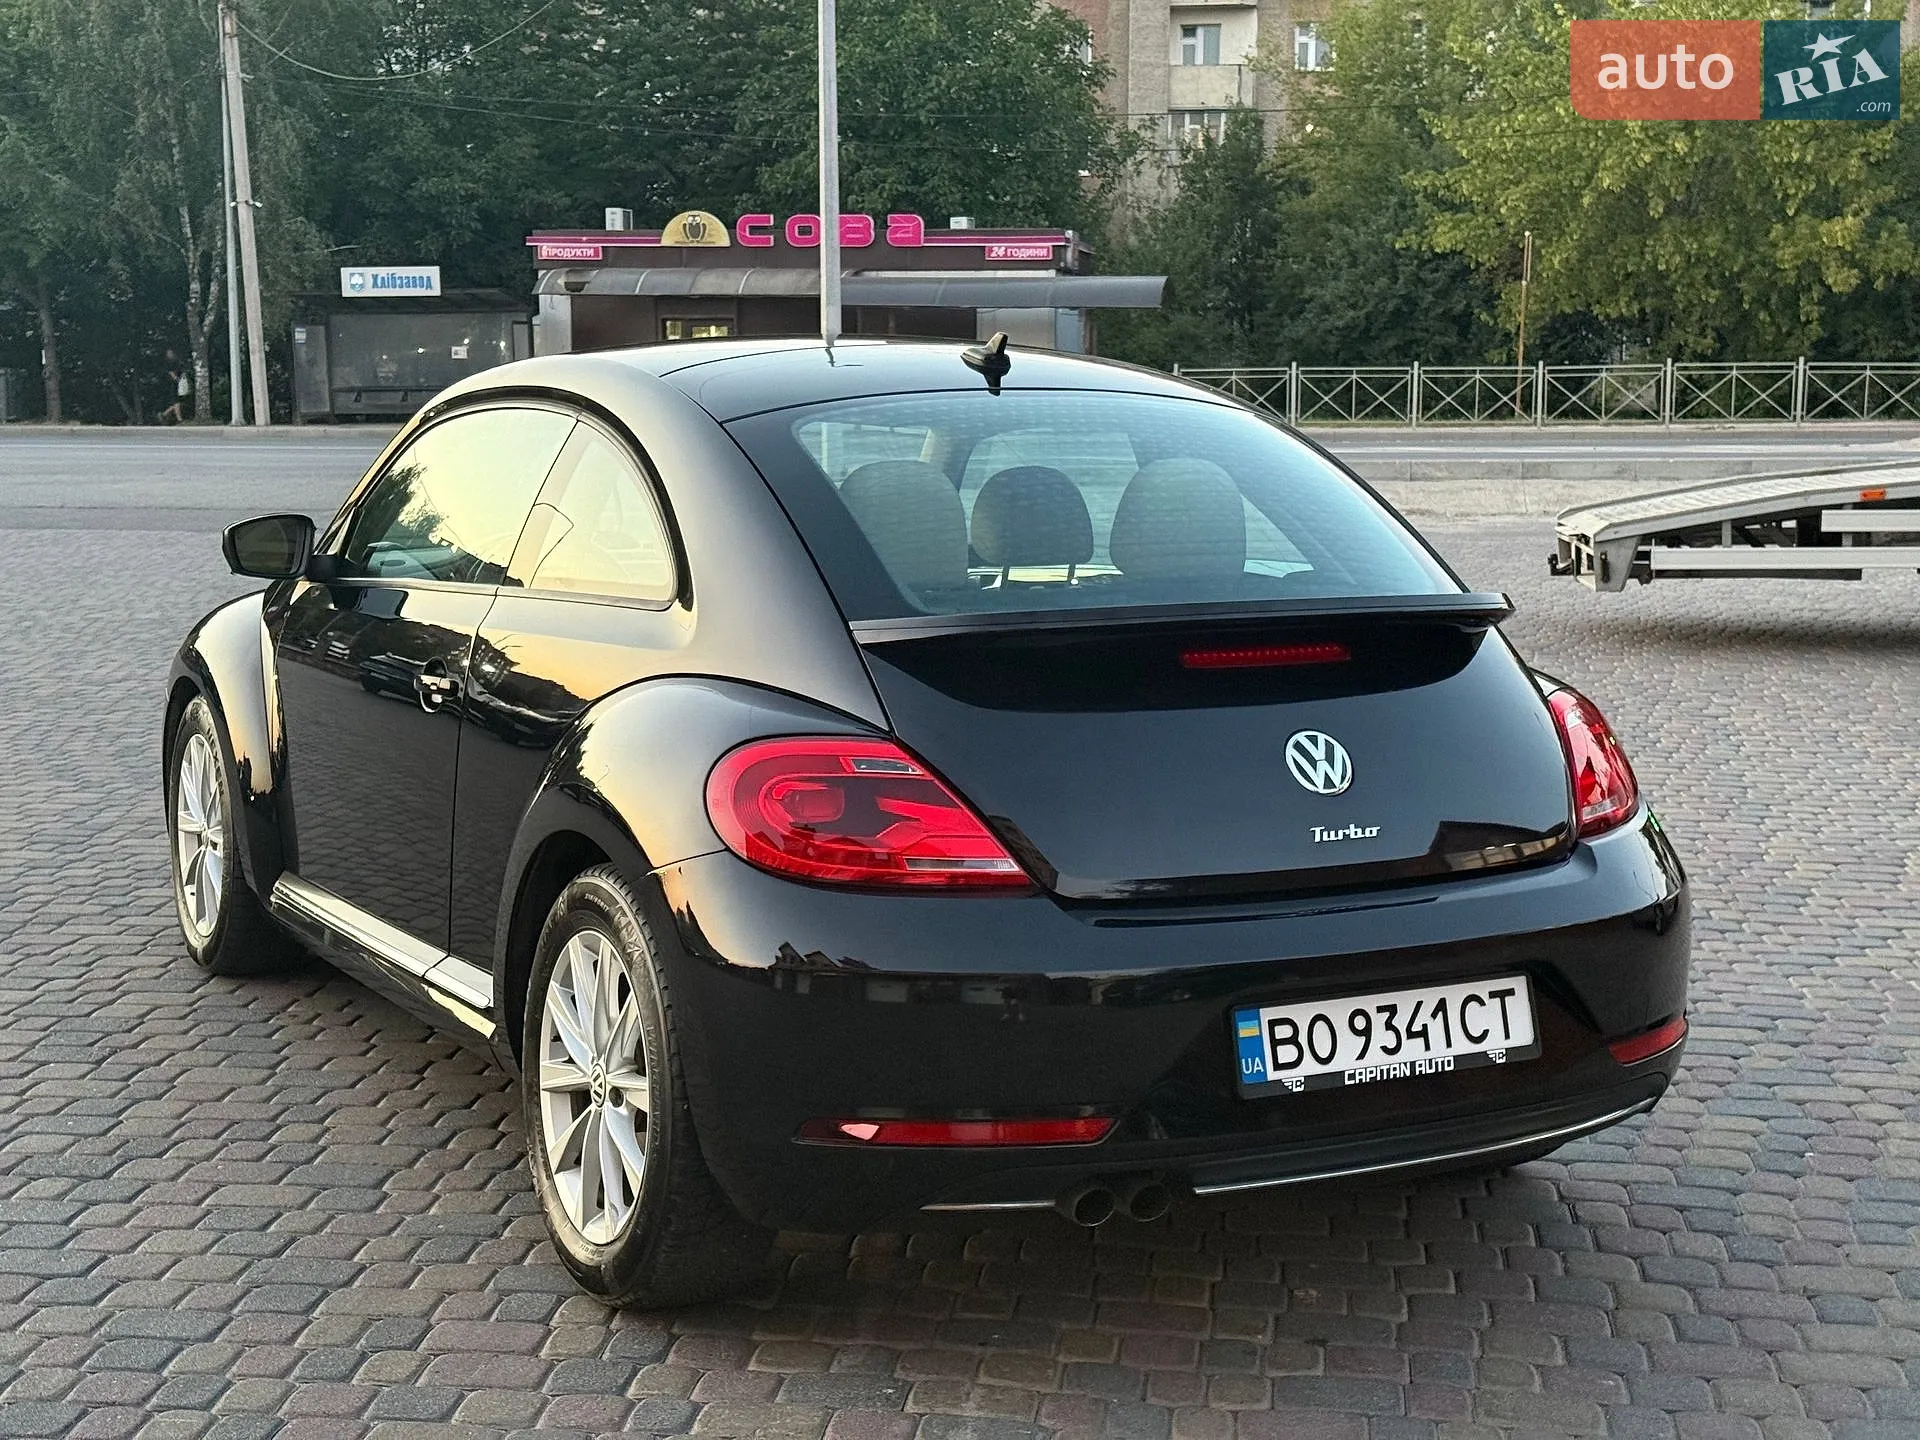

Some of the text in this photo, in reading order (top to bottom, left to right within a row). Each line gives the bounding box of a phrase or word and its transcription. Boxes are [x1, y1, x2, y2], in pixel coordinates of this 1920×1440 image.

[990, 246, 1006, 257] 24
[371, 272, 433, 290] Хлібзавод
[1310, 823, 1381, 843] Turbo
[1241, 1057, 1264, 1075] UA
[1344, 1055, 1456, 1086] CAPITAN AUTO
